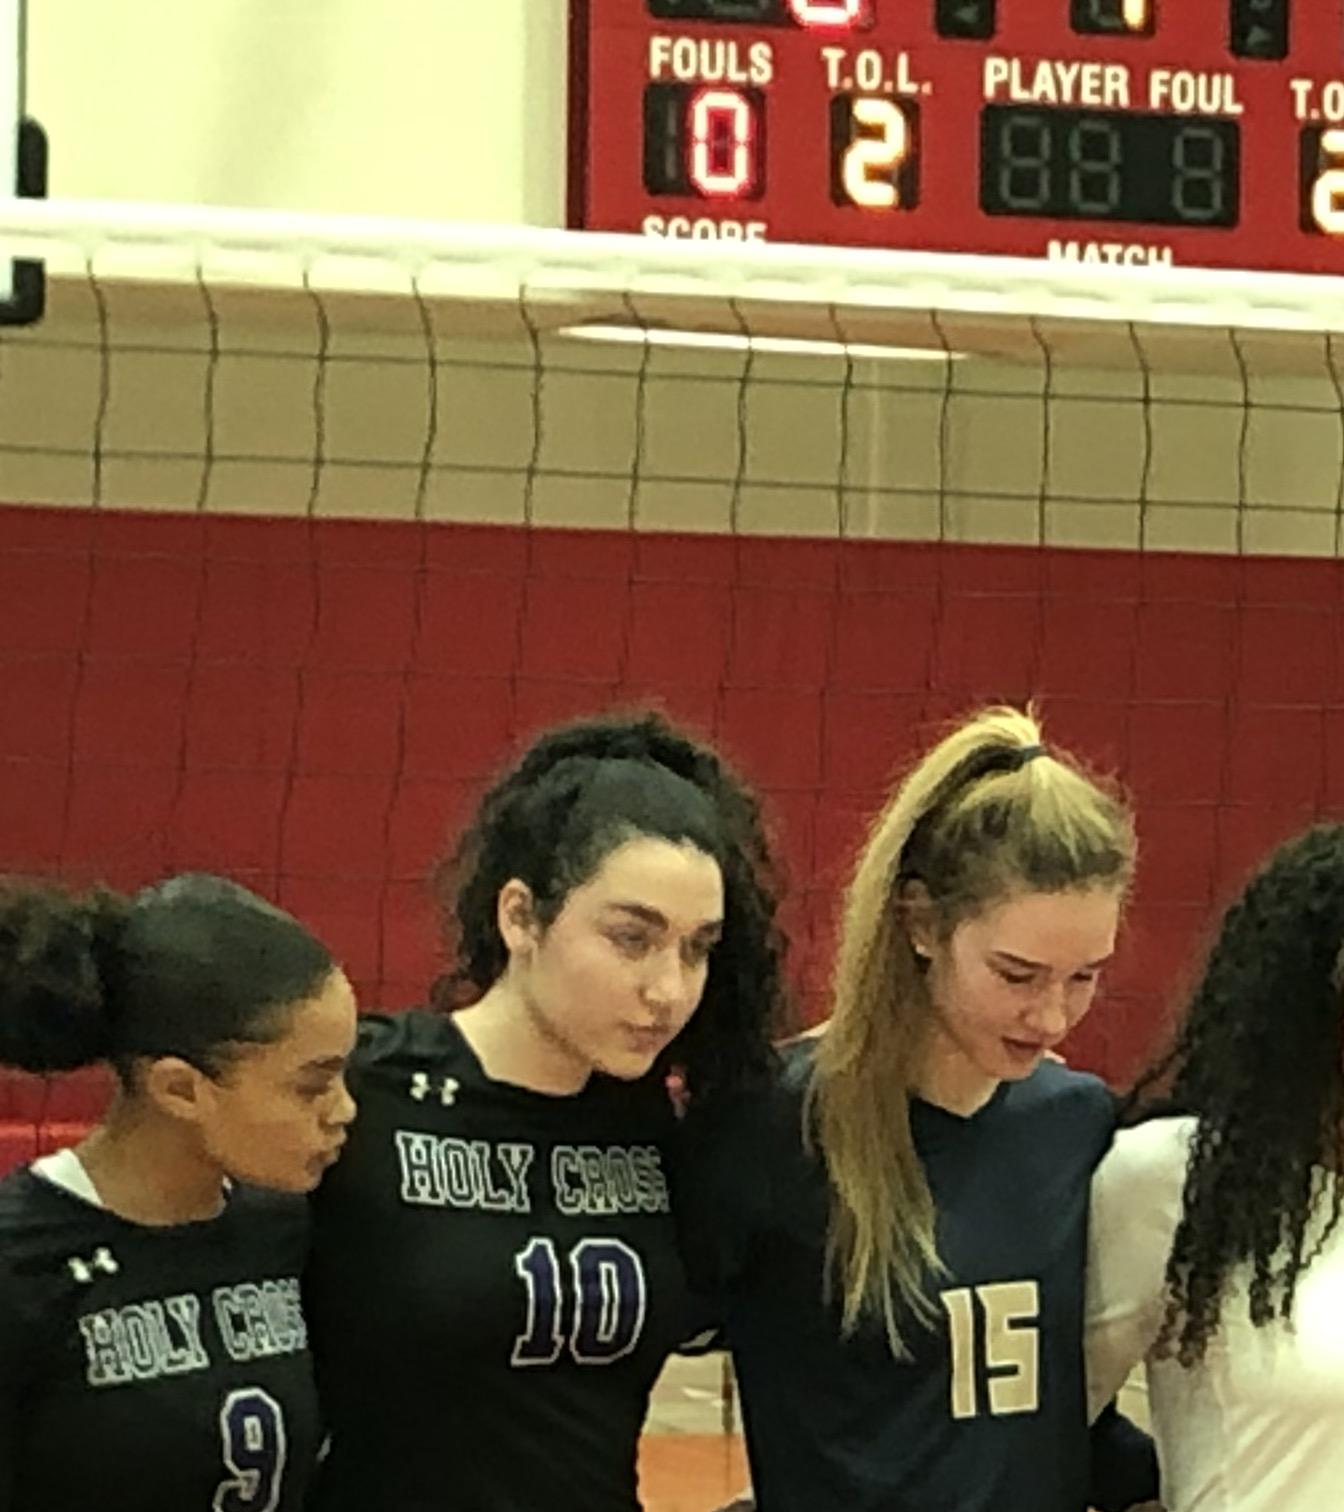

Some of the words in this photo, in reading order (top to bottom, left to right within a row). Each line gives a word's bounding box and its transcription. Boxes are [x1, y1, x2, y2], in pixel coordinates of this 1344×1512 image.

[648, 36, 773, 84] FOULS
[821, 47, 933, 95] T.O.L.
[983, 56, 1130, 108] PLAYER
[1150, 69, 1245, 114] FOUL
[842, 97, 907, 207] 2
[395, 1130, 534, 1213] HOLY
[78, 1294, 210, 1386] HOLY
[510, 1238, 646, 1367] 10
[940, 1279, 1040, 1420] 15
